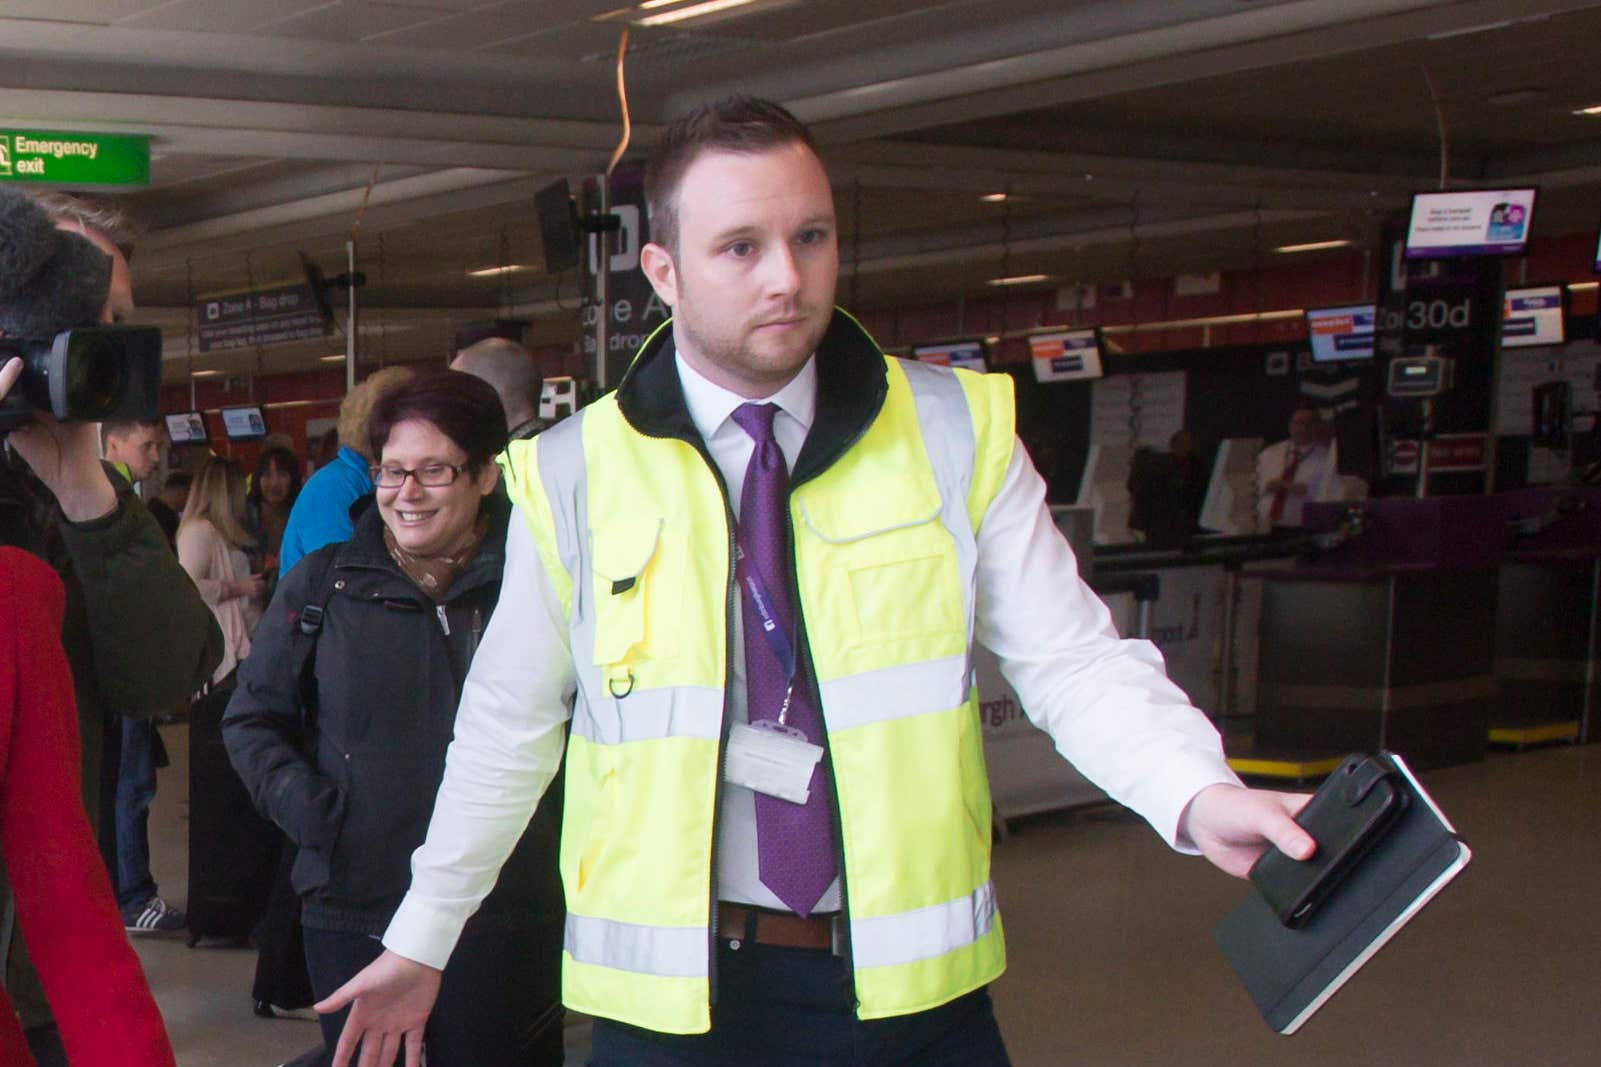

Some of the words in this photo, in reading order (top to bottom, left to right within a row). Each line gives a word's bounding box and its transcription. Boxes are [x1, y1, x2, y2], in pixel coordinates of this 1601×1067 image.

[15, 136, 98, 160] Emergency
[16, 157, 45, 174] exit
[1407, 299, 1470, 329] 30d
